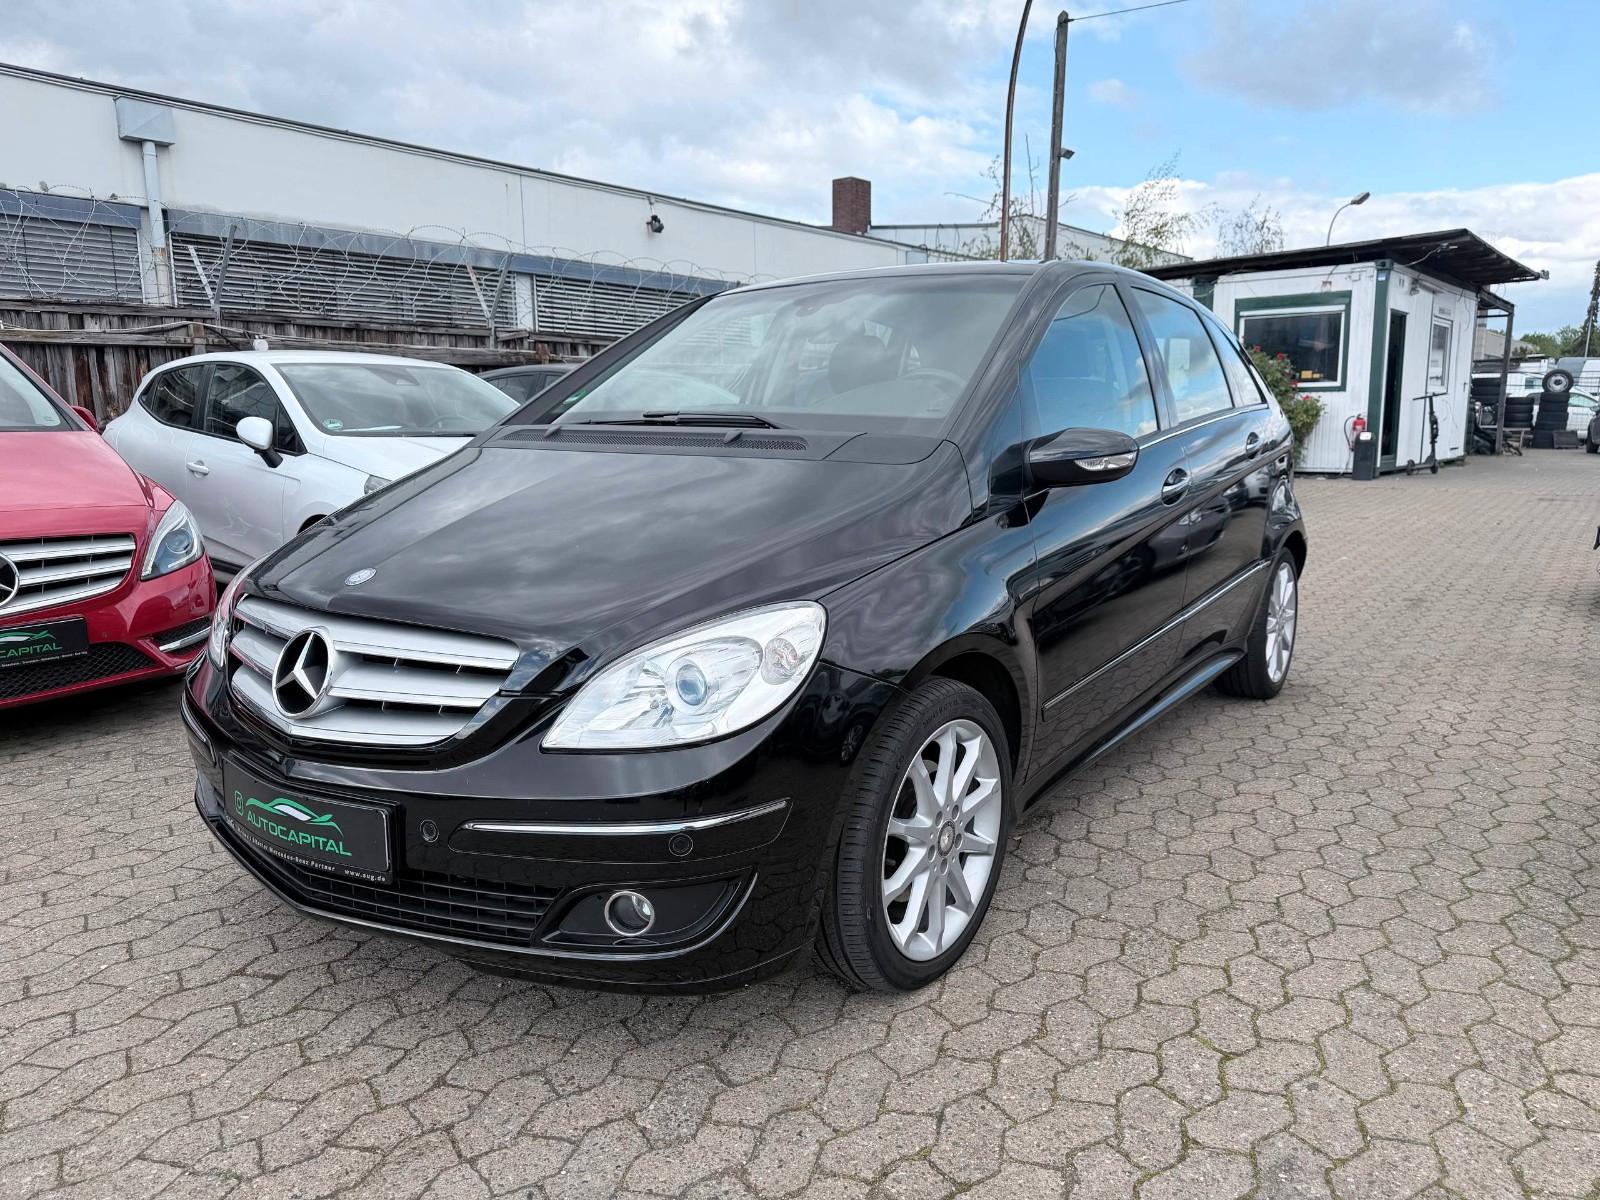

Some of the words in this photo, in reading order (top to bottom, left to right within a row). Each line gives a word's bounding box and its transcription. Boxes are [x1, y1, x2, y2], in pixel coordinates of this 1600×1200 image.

[247, 810, 352, 856] AUTOCAPITAL
[269, 846, 309, 865] Mercedes-Benz
[310, 860, 335, 872] Partner
